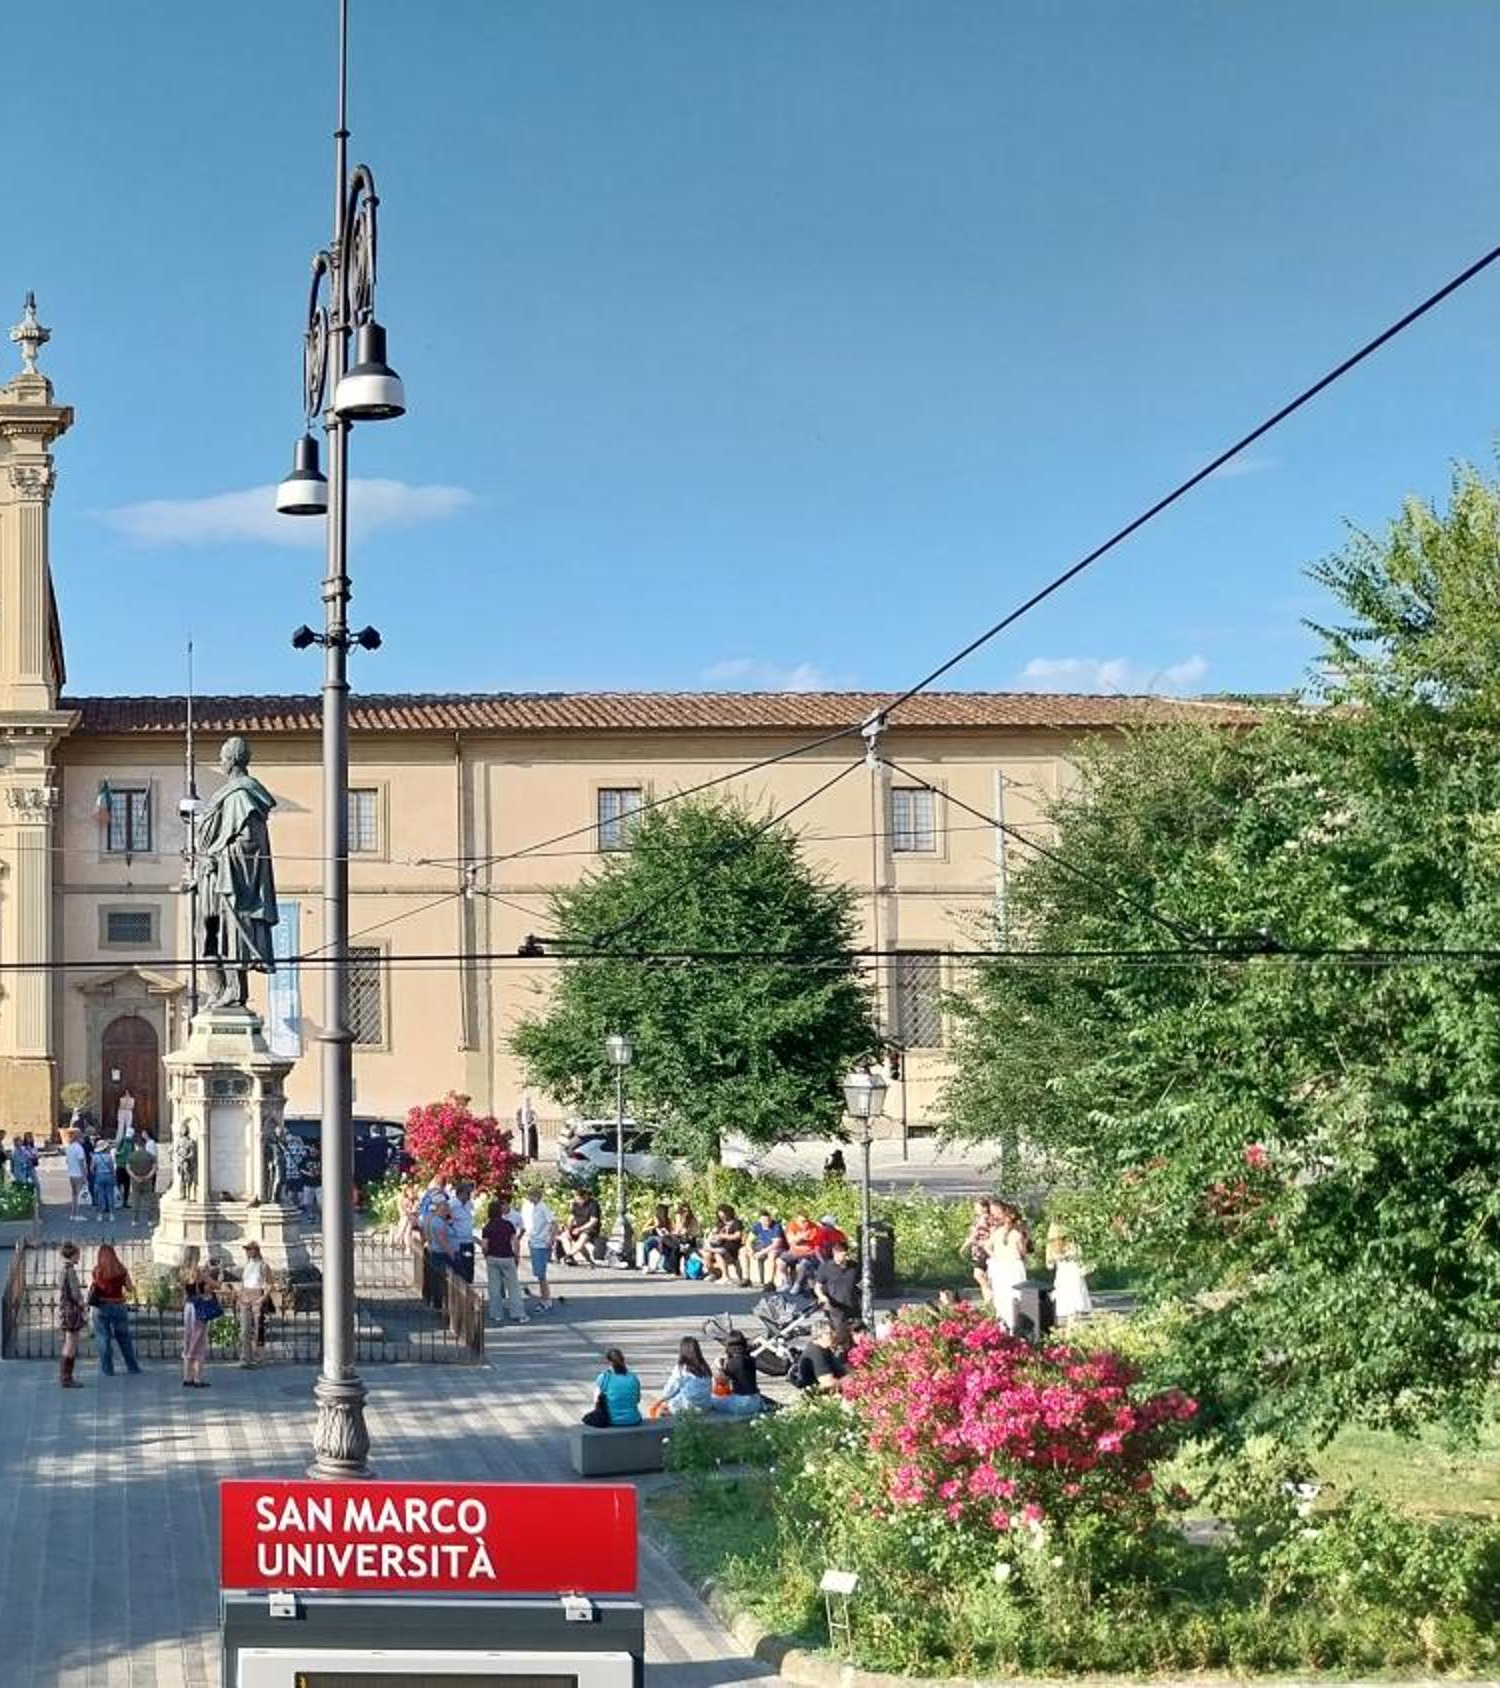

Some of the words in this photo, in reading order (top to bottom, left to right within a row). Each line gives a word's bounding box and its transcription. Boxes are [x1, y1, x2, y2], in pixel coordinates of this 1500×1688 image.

[255, 1495, 333, 1533] SAN
[343, 1497, 488, 1535] MARCO
[257, 1536, 497, 1579] UNIVERSITÀ
